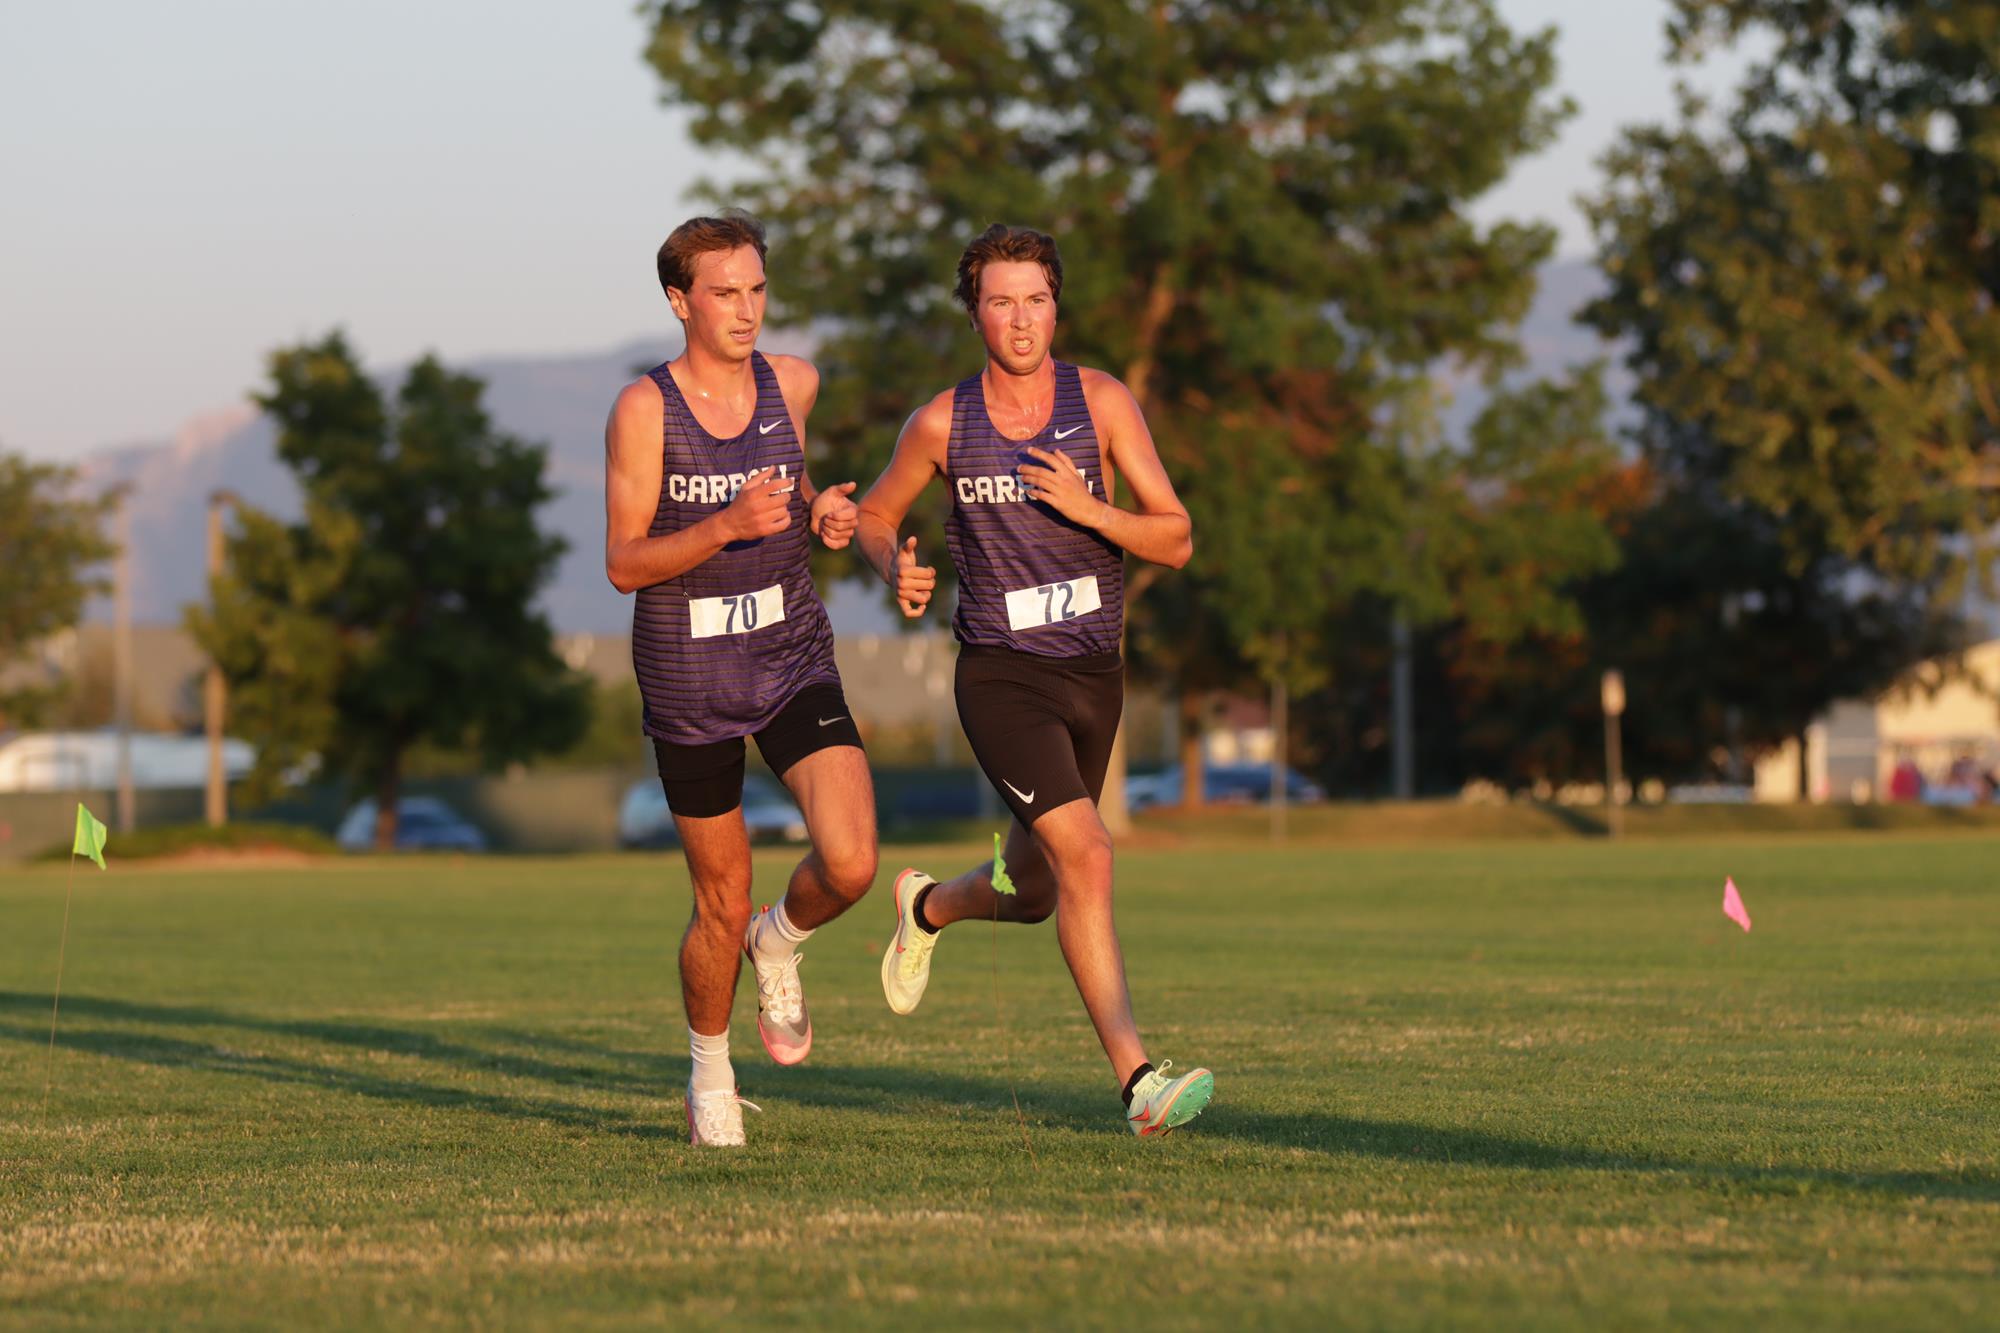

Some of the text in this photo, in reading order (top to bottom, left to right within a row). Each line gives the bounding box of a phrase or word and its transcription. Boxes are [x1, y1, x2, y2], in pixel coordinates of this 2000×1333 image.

[669, 465, 795, 504] CARRL
[722, 594, 757, 633] 70
[1037, 582, 1076, 624] 72
